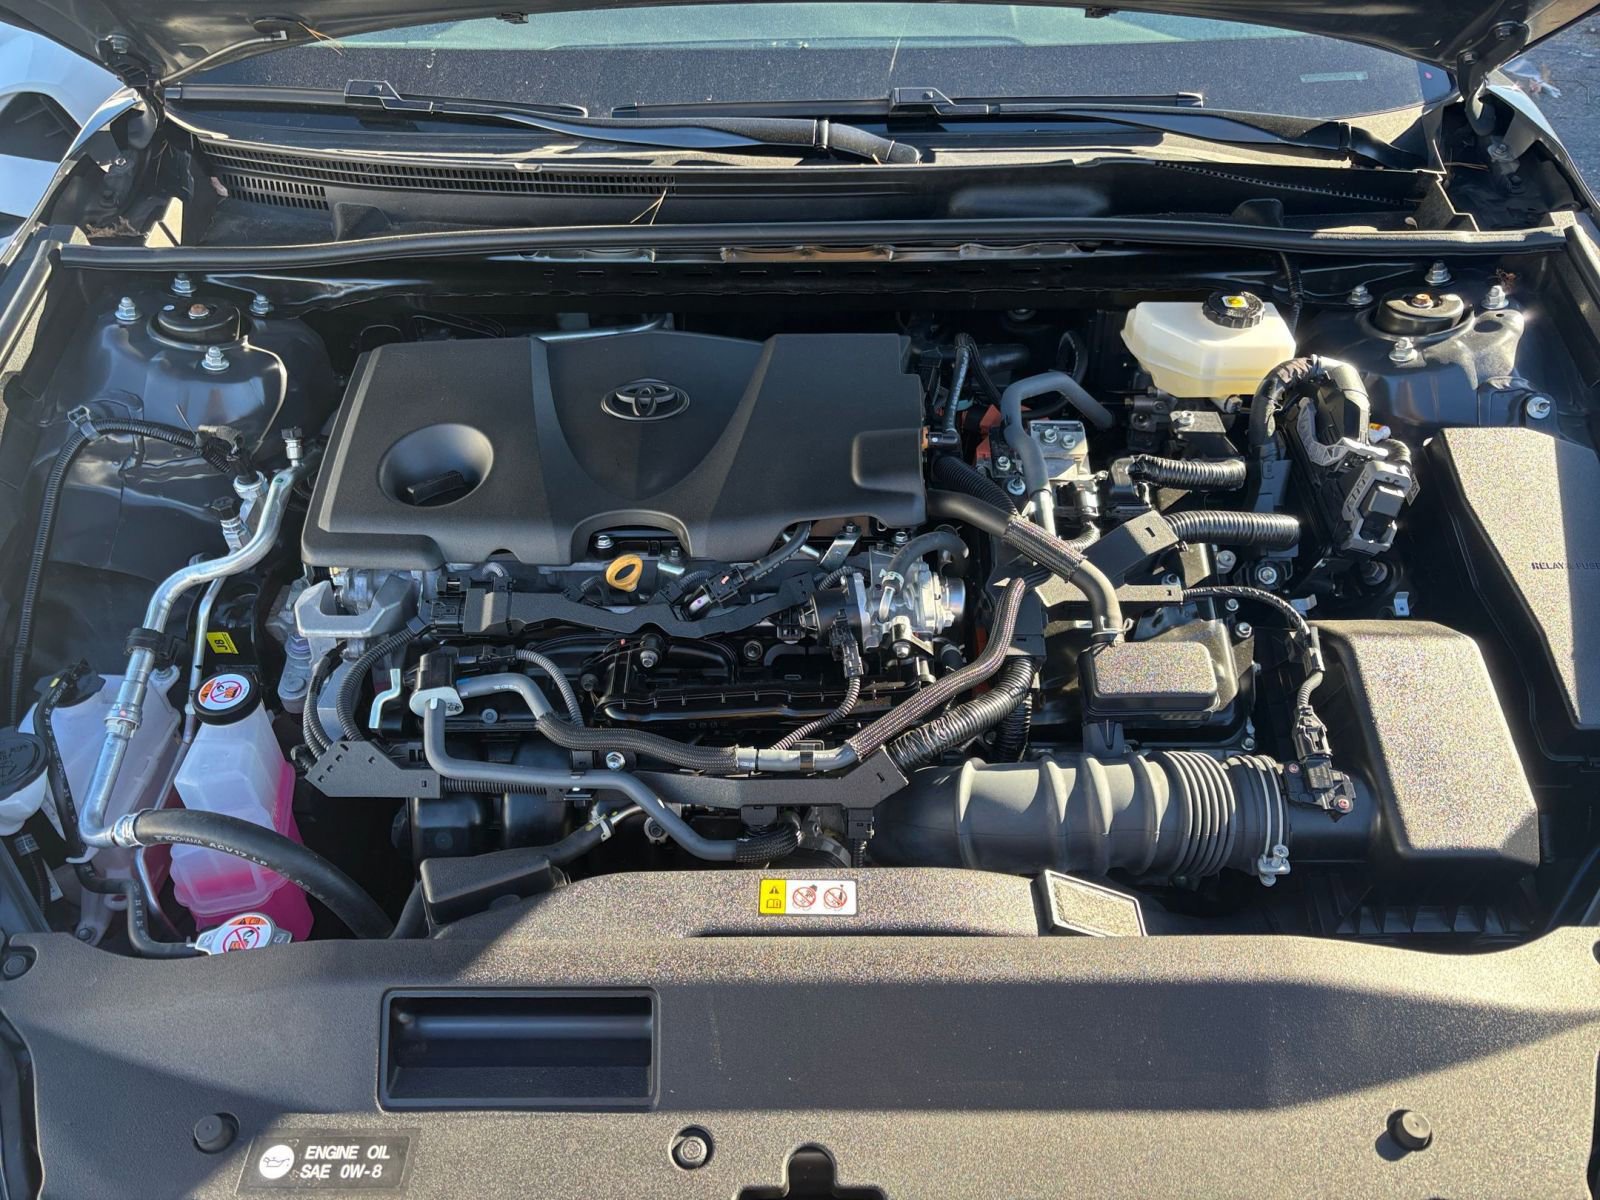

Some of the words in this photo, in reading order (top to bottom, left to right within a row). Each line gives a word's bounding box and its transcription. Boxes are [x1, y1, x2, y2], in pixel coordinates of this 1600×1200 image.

[1531, 562, 1564, 570] RELAY
[305, 1145, 360, 1160] ENGINE
[367, 1145, 390, 1160] OIL
[300, 1163, 332, 1179] SAE
[340, 1163, 383, 1179] 0W-8
